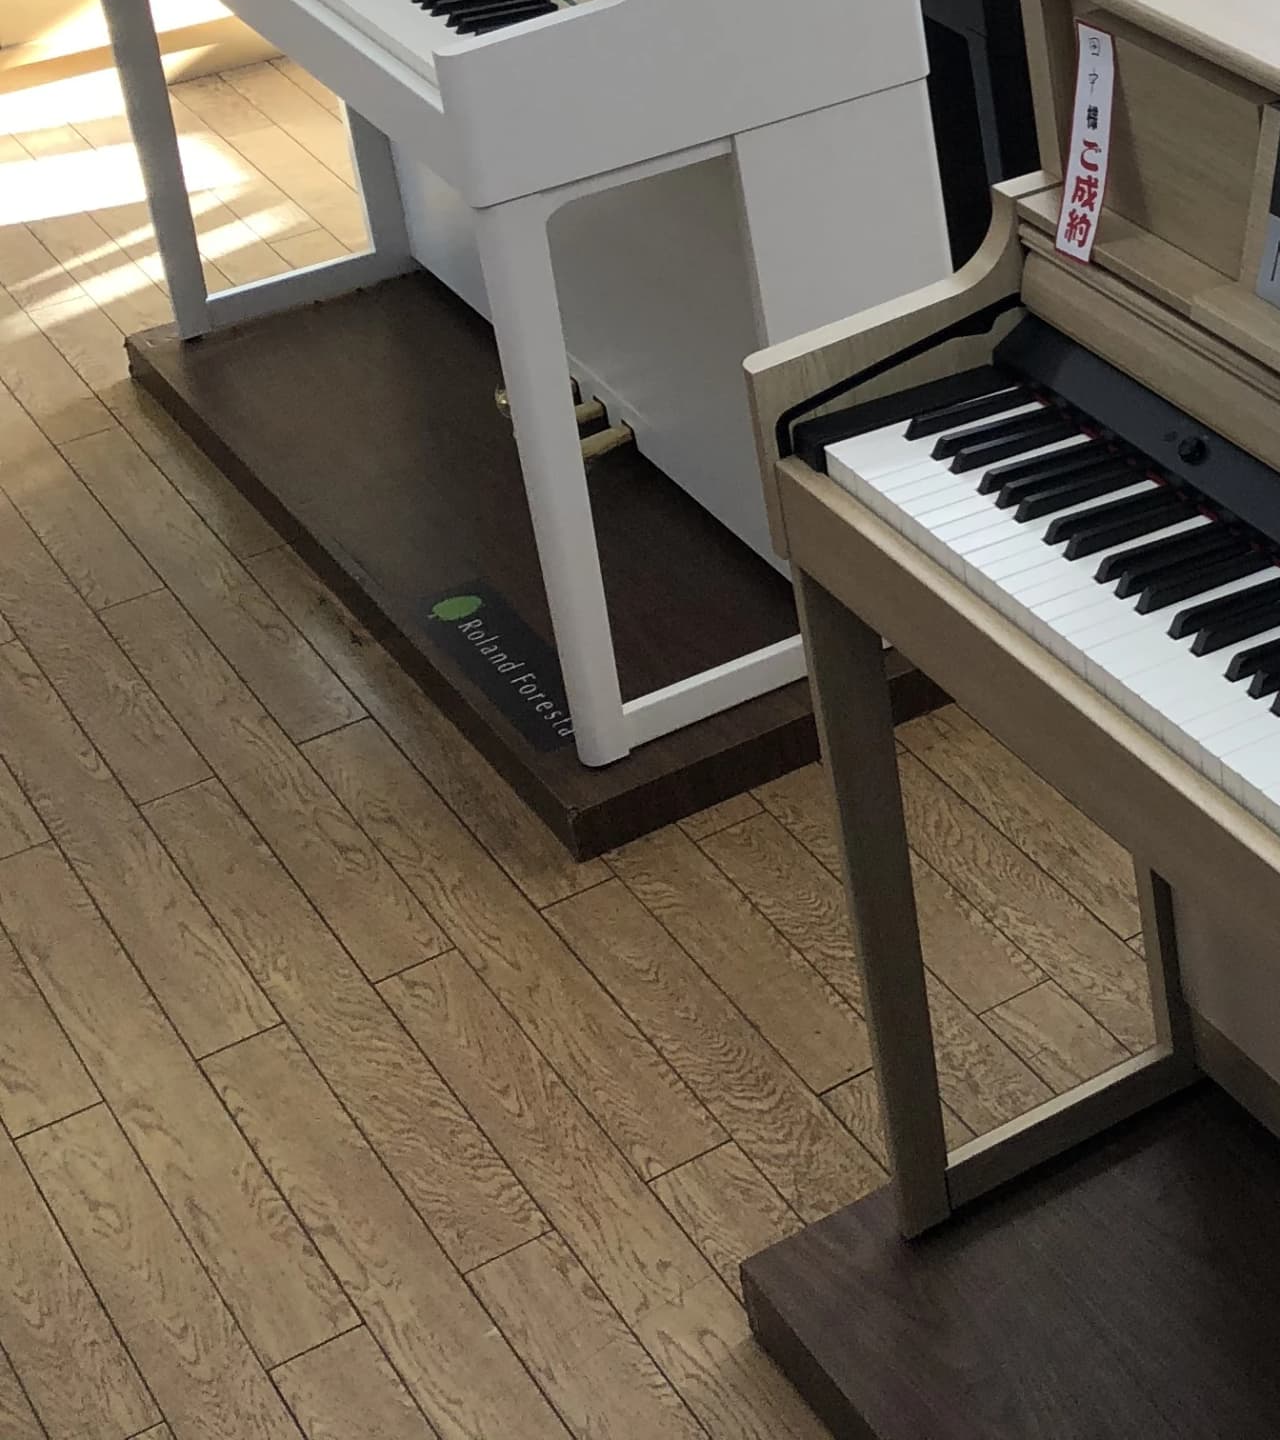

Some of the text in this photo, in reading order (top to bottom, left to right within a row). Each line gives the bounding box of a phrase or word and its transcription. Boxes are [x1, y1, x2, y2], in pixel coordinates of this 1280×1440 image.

[1063, 138, 1102, 249] ご成約
[458, 617, 576, 738] Roland Foresta
